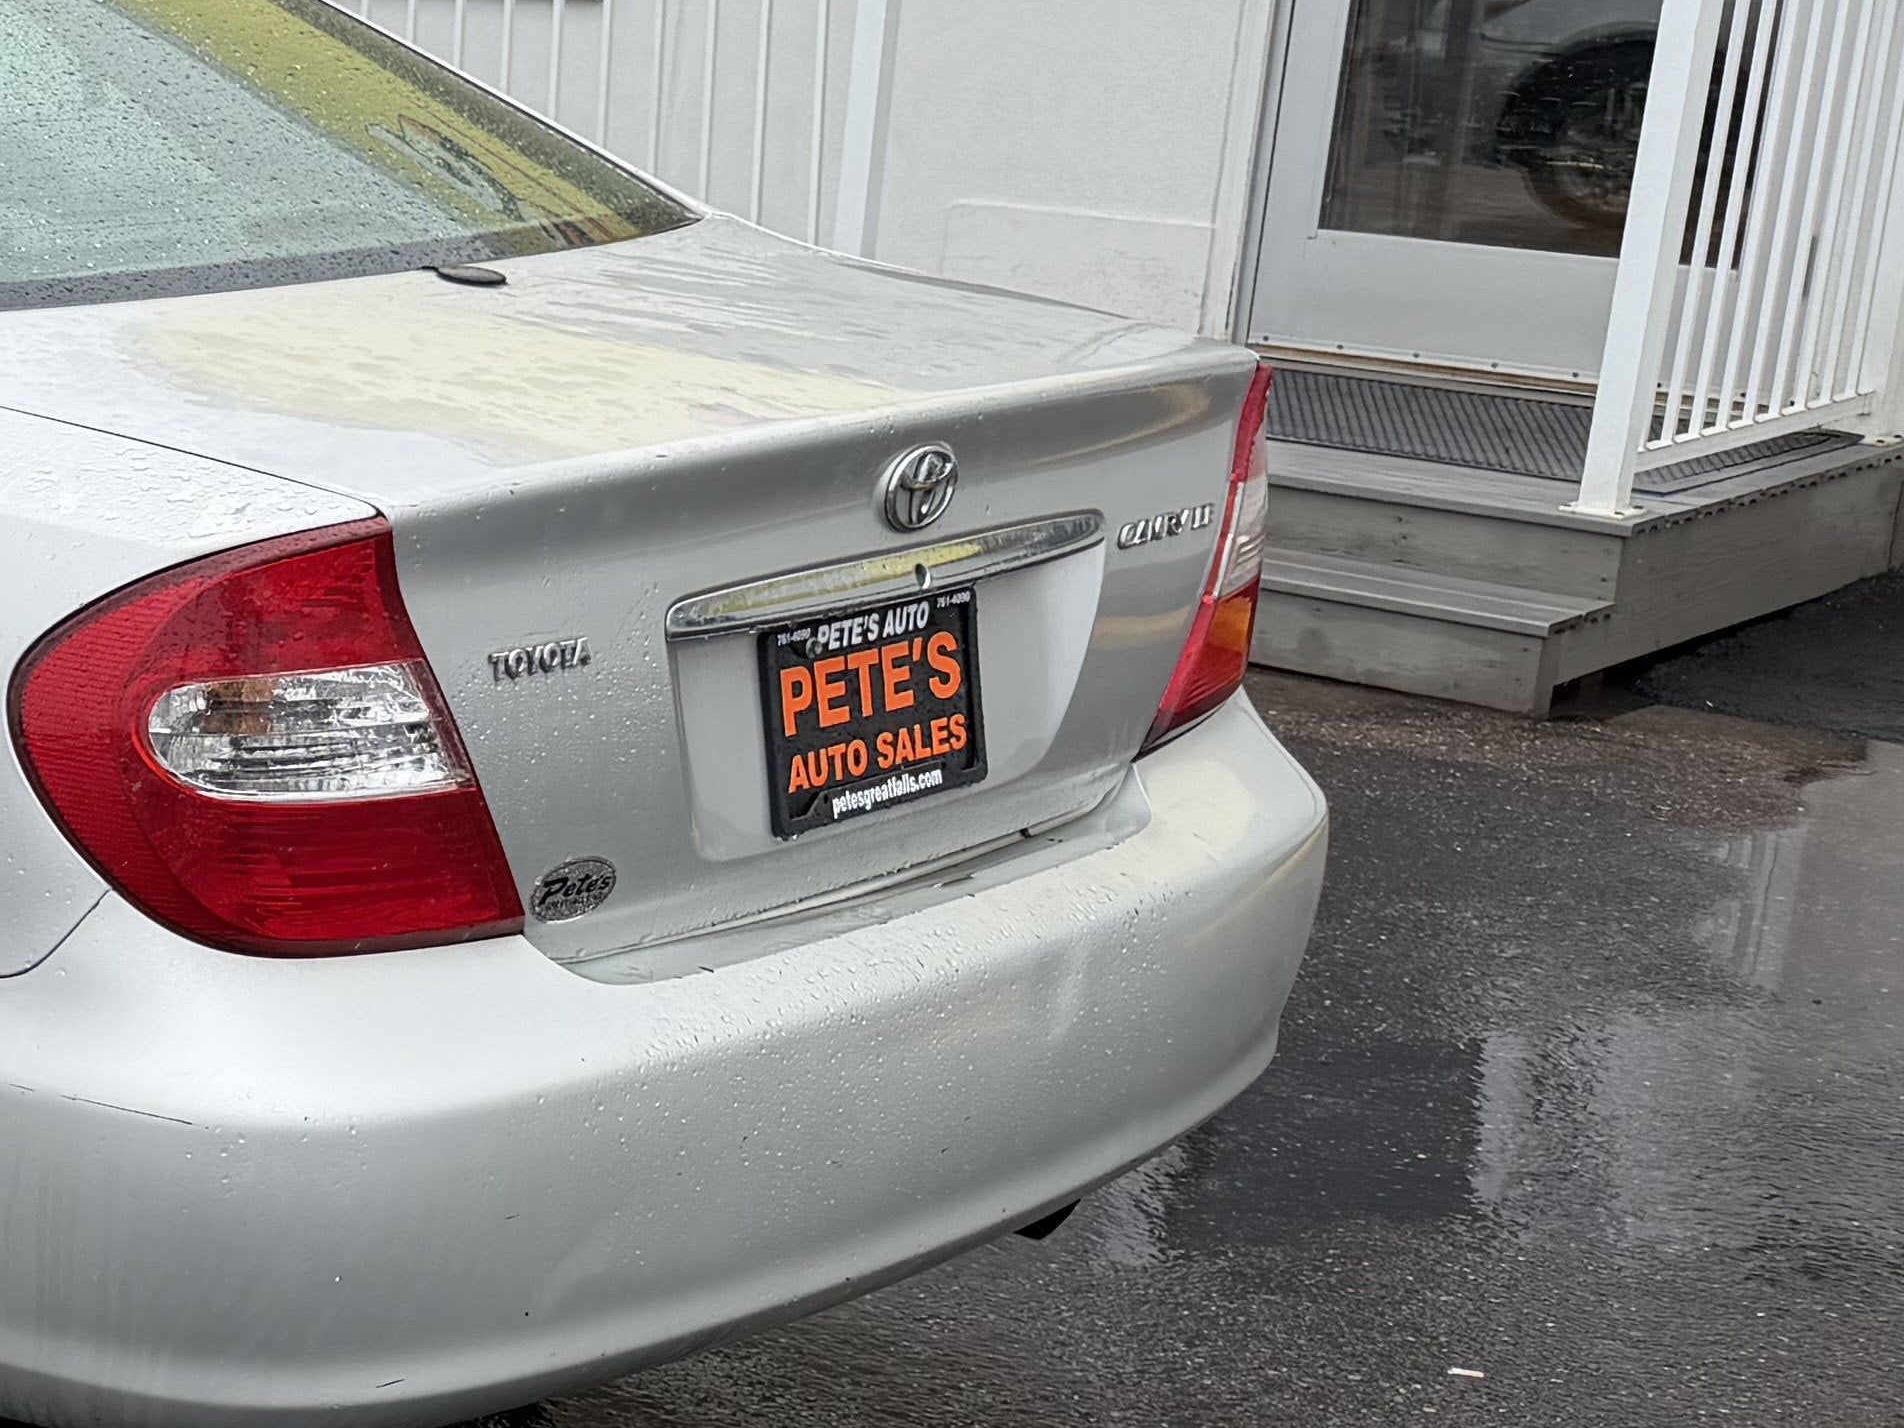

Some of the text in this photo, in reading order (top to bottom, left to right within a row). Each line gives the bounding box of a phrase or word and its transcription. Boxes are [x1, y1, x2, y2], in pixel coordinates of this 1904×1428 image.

[817, 602, 929, 651] PETE'S AUTO
[488, 636, 591, 683] TOYOTA
[780, 631, 962, 737] PETE'S
[788, 713, 968, 794] AUTO SALES
[832, 769, 942, 819] petesgreatfalls.com
[538, 873, 612, 906] Pete's
